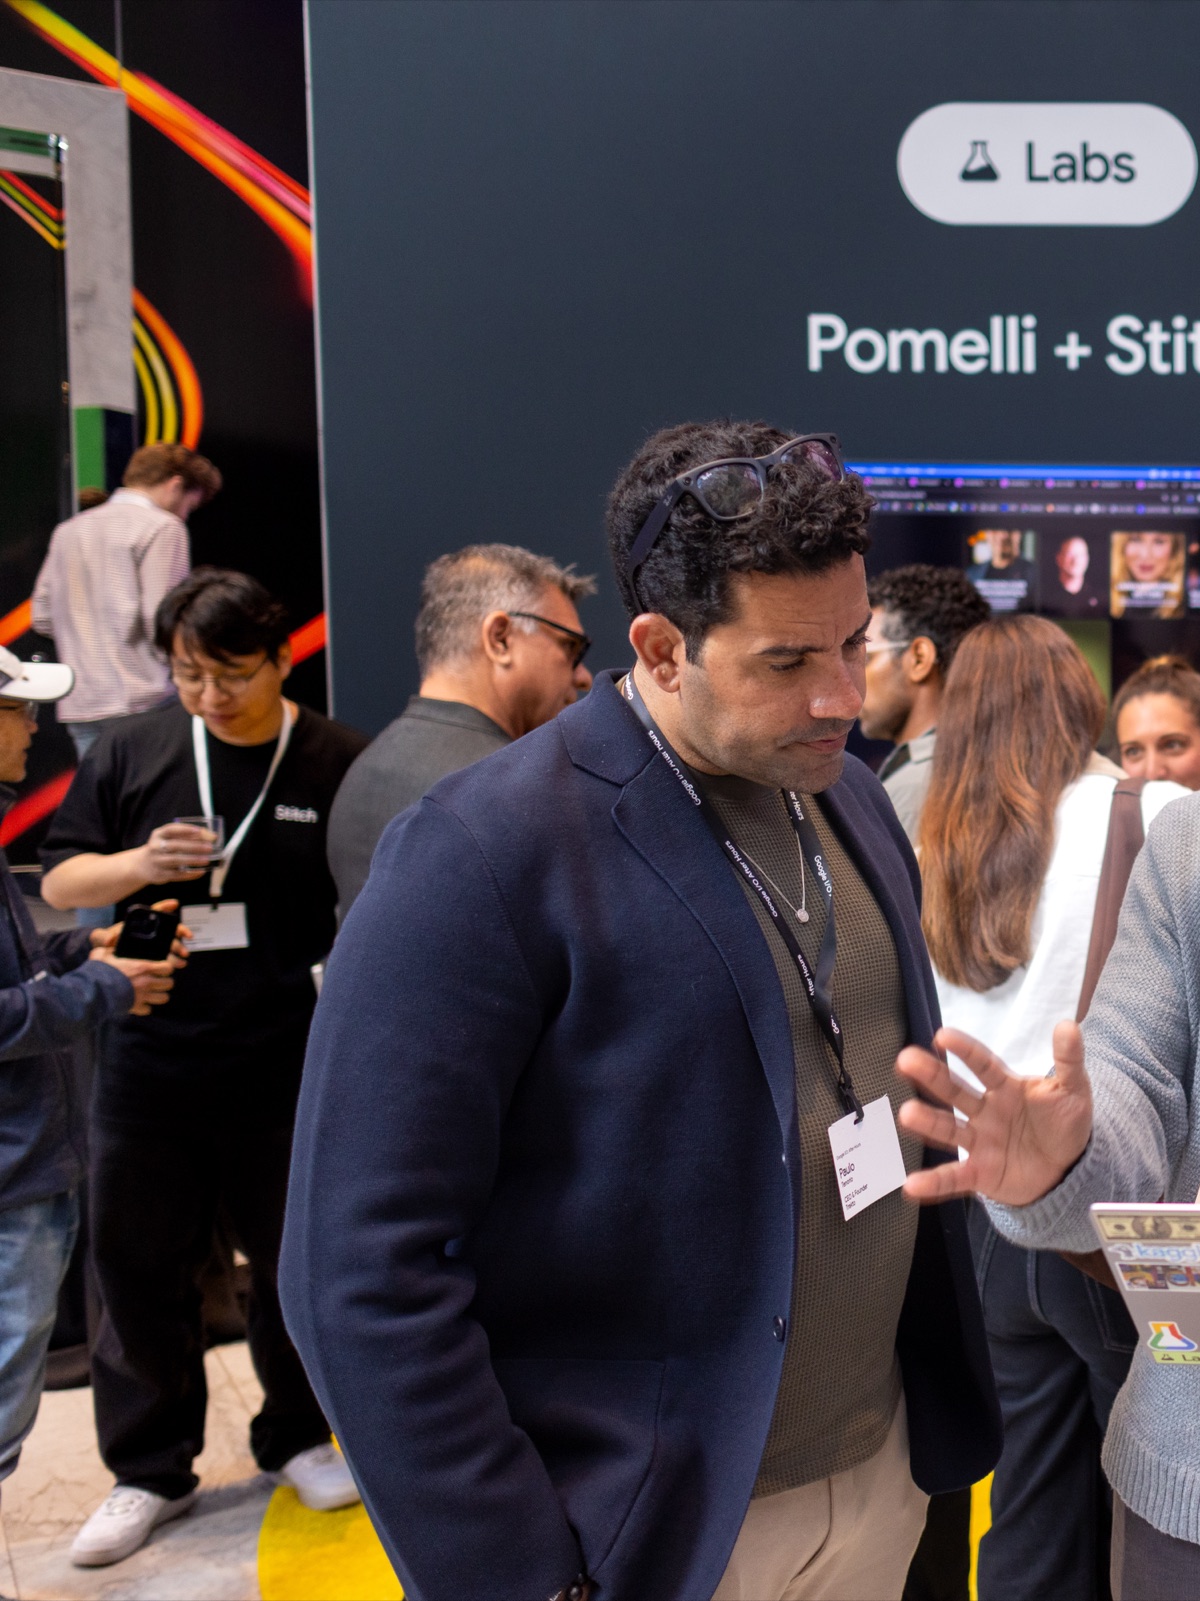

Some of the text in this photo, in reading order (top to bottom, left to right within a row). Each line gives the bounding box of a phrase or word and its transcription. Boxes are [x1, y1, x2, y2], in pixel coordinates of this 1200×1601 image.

[1025, 141, 1137, 183] Labs
[807, 313, 1038, 374] Pomelli
[1054, 331, 1092, 371] +
[274, 804, 319, 823] Stitch
[793, 801, 805, 821] Hours
[725, 840, 778, 917] Google I/O After Hours
[814, 855, 833, 893] Google I/O
[797, 954, 810, 978] Hours
[838, 1162, 856, 1179] Paulo
